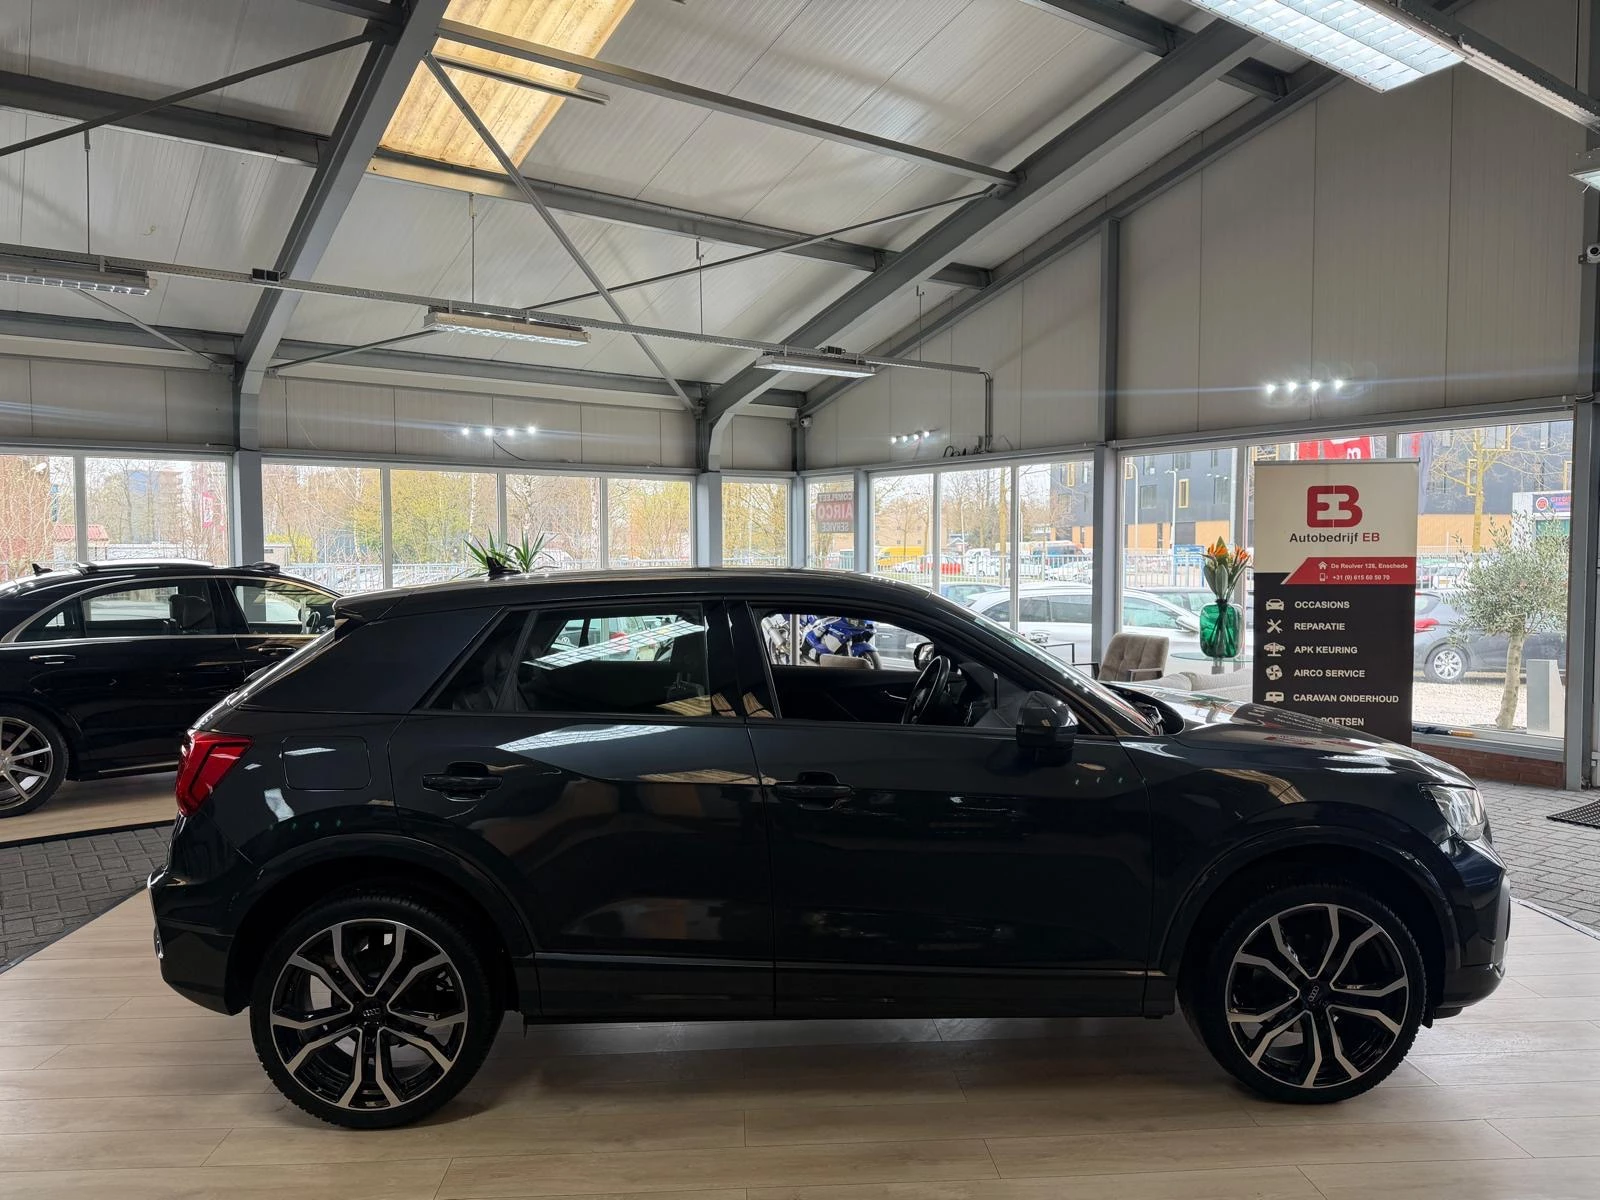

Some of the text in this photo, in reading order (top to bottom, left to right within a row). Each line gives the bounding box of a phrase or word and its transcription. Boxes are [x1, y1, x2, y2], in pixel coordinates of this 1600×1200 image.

[1307, 485, 1363, 528] EB
[1289, 532, 1380, 544] Autobedrijf EB
[1294, 600, 1350, 609] OCCASIONS
[1294, 622, 1346, 631] REPARATIE
[1294, 645, 1358, 654] APK KEURING
[1294, 669, 1366, 678] AIRCO SERVICE
[1293, 694, 1399, 703] CARAVAN ONDERHOUD
